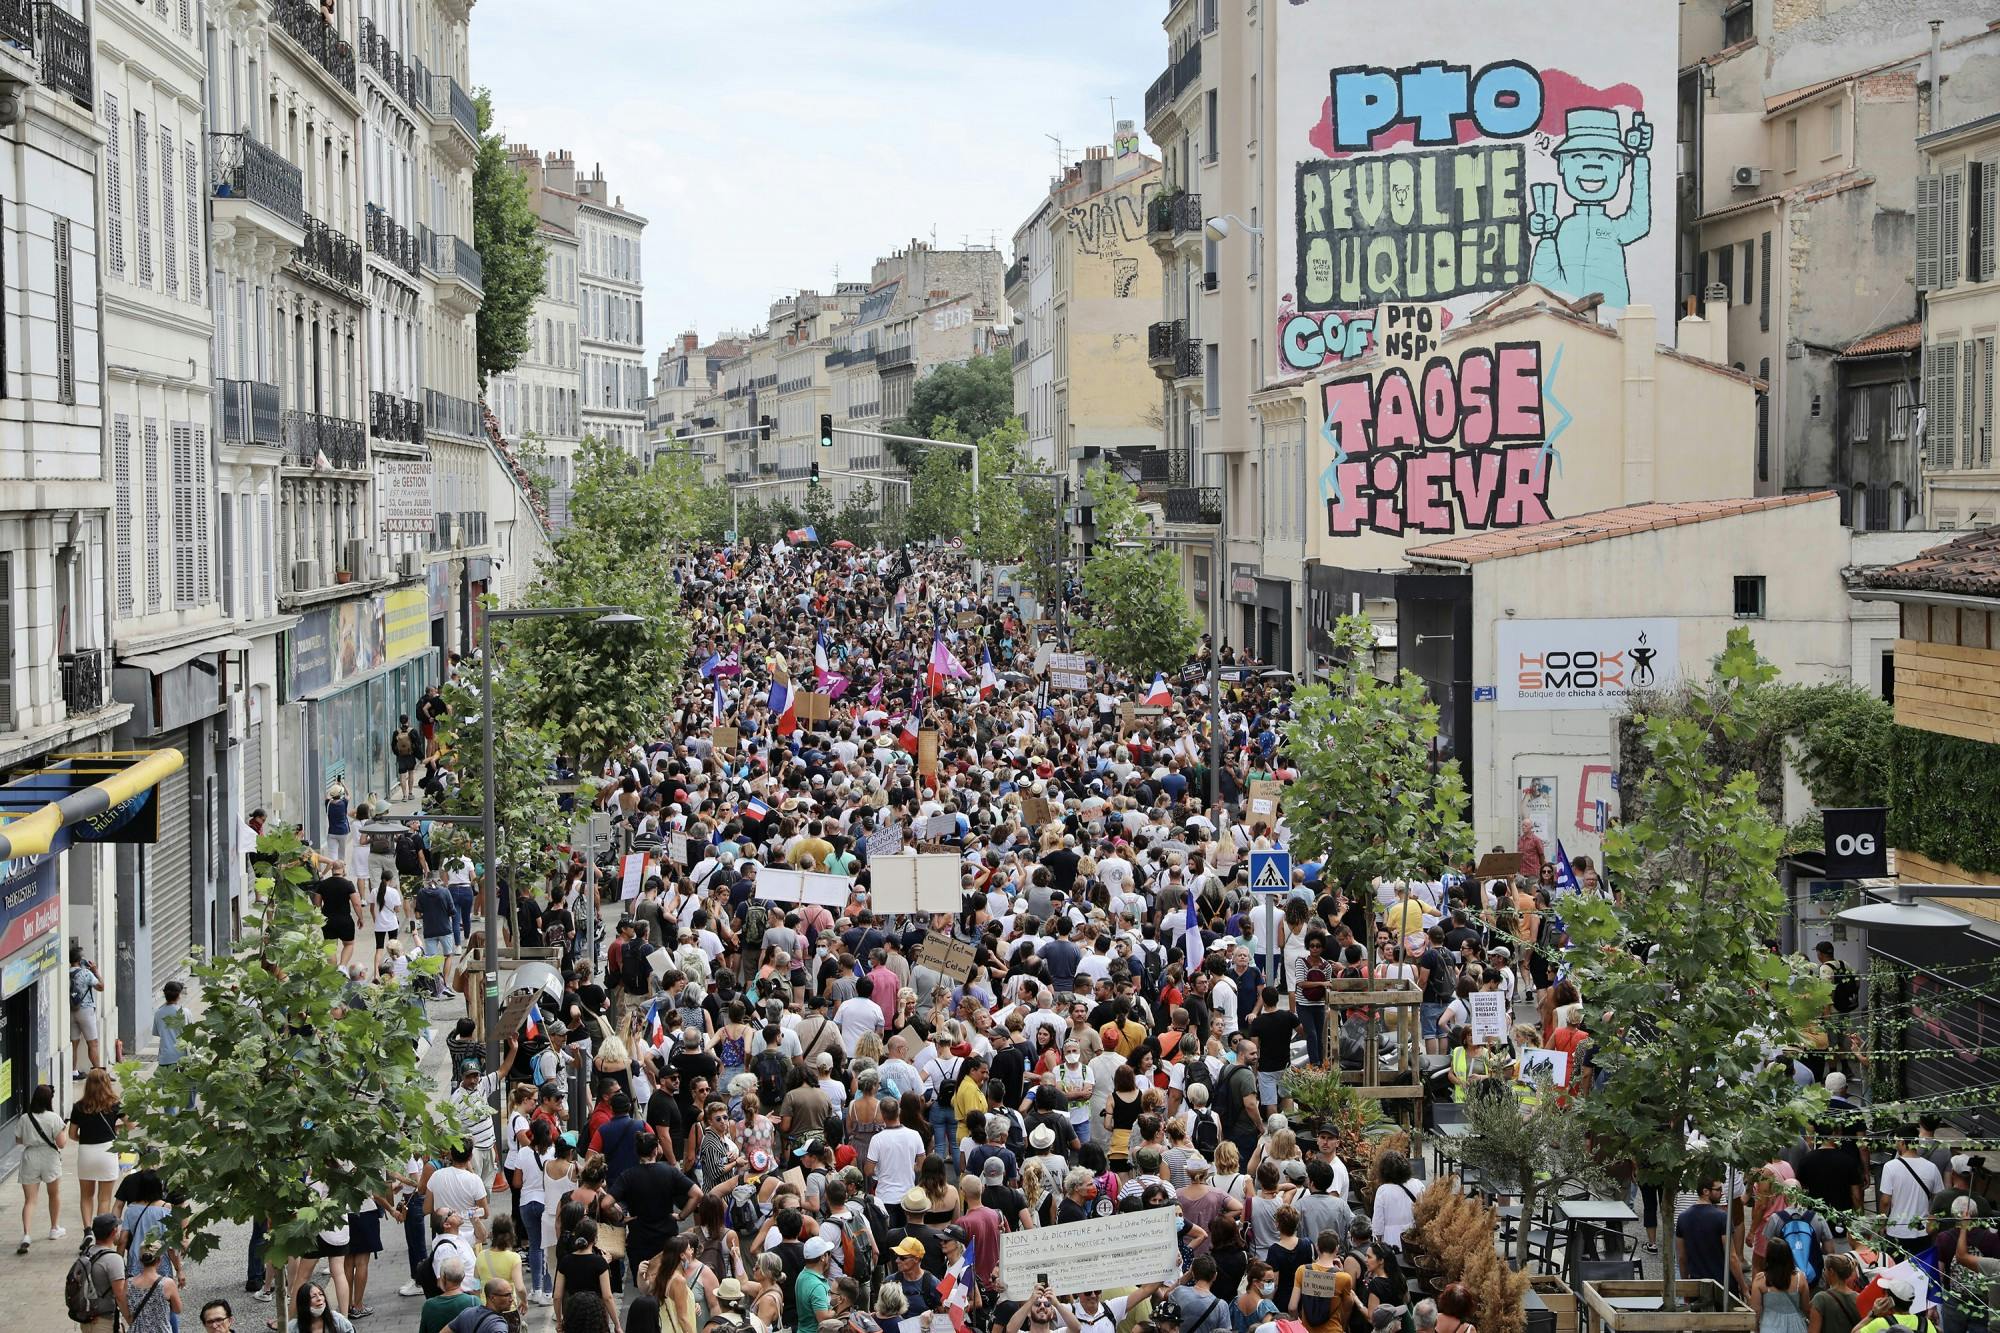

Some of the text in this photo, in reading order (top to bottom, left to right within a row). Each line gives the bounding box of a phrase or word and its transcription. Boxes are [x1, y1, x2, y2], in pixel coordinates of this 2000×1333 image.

[1330, 59, 1545, 152] PTO
[1304, 149, 1521, 233] REVOLTE
[1387, 305, 1433, 333] PTO
[1321, 340, 1545, 458] TAOSE
[402, 477, 426, 487] GESTION
[1520, 651, 1624, 670] HOOK
[1518, 671, 1624, 690] SMOK
[1518, 690, 1554, 699] Boutique
[94, 809, 119, 834] MULTI
[1836, 834, 1876, 856] OG
[1006, 1235, 1028, 1246] NON
[1052, 1226, 1091, 1238] DICTATURE
